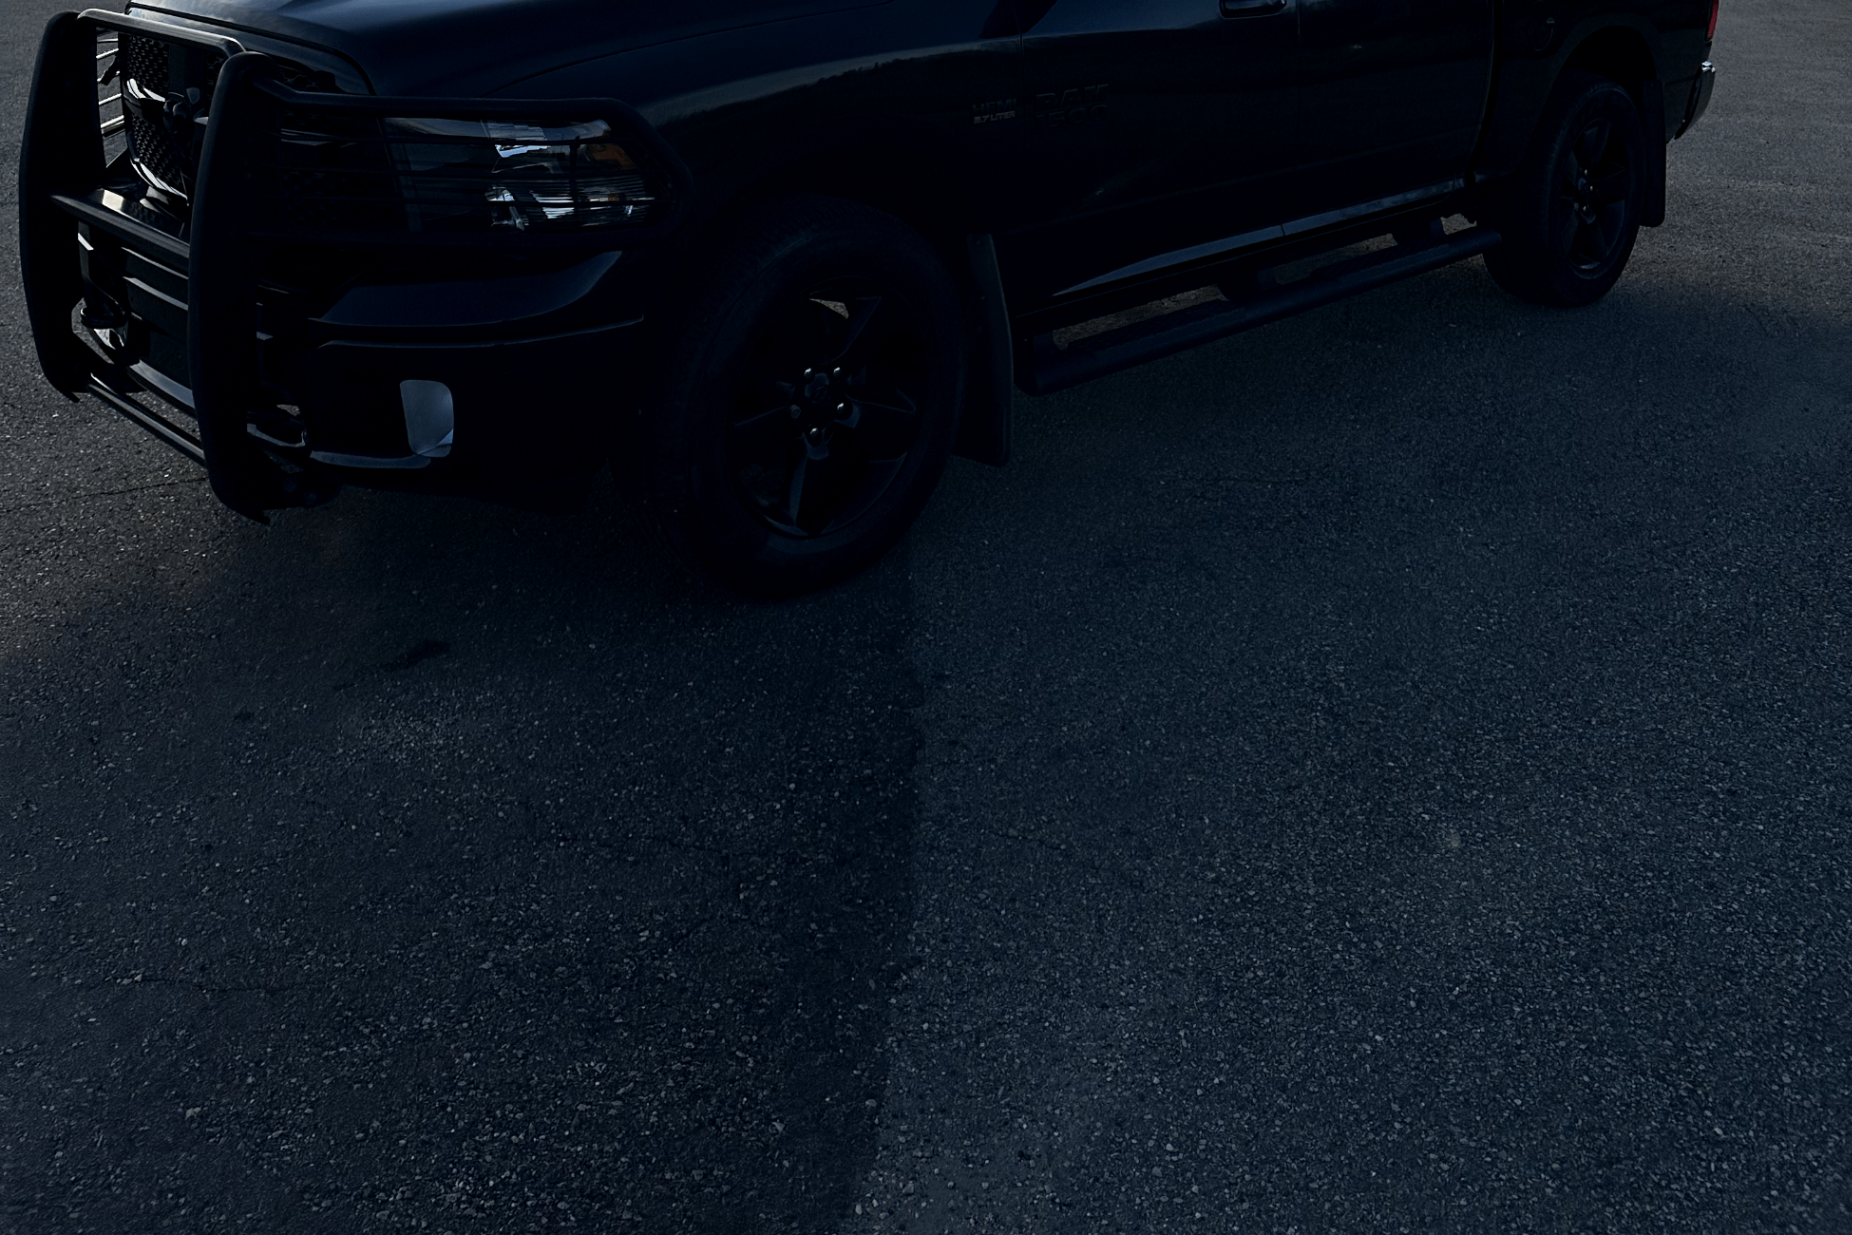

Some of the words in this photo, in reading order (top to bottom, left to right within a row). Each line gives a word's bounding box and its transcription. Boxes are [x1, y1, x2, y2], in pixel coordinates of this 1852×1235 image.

[972, 98, 1017, 114] HEMI
[1034, 83, 1110, 111] RAM
[1034, 104, 1108, 129] 1500
